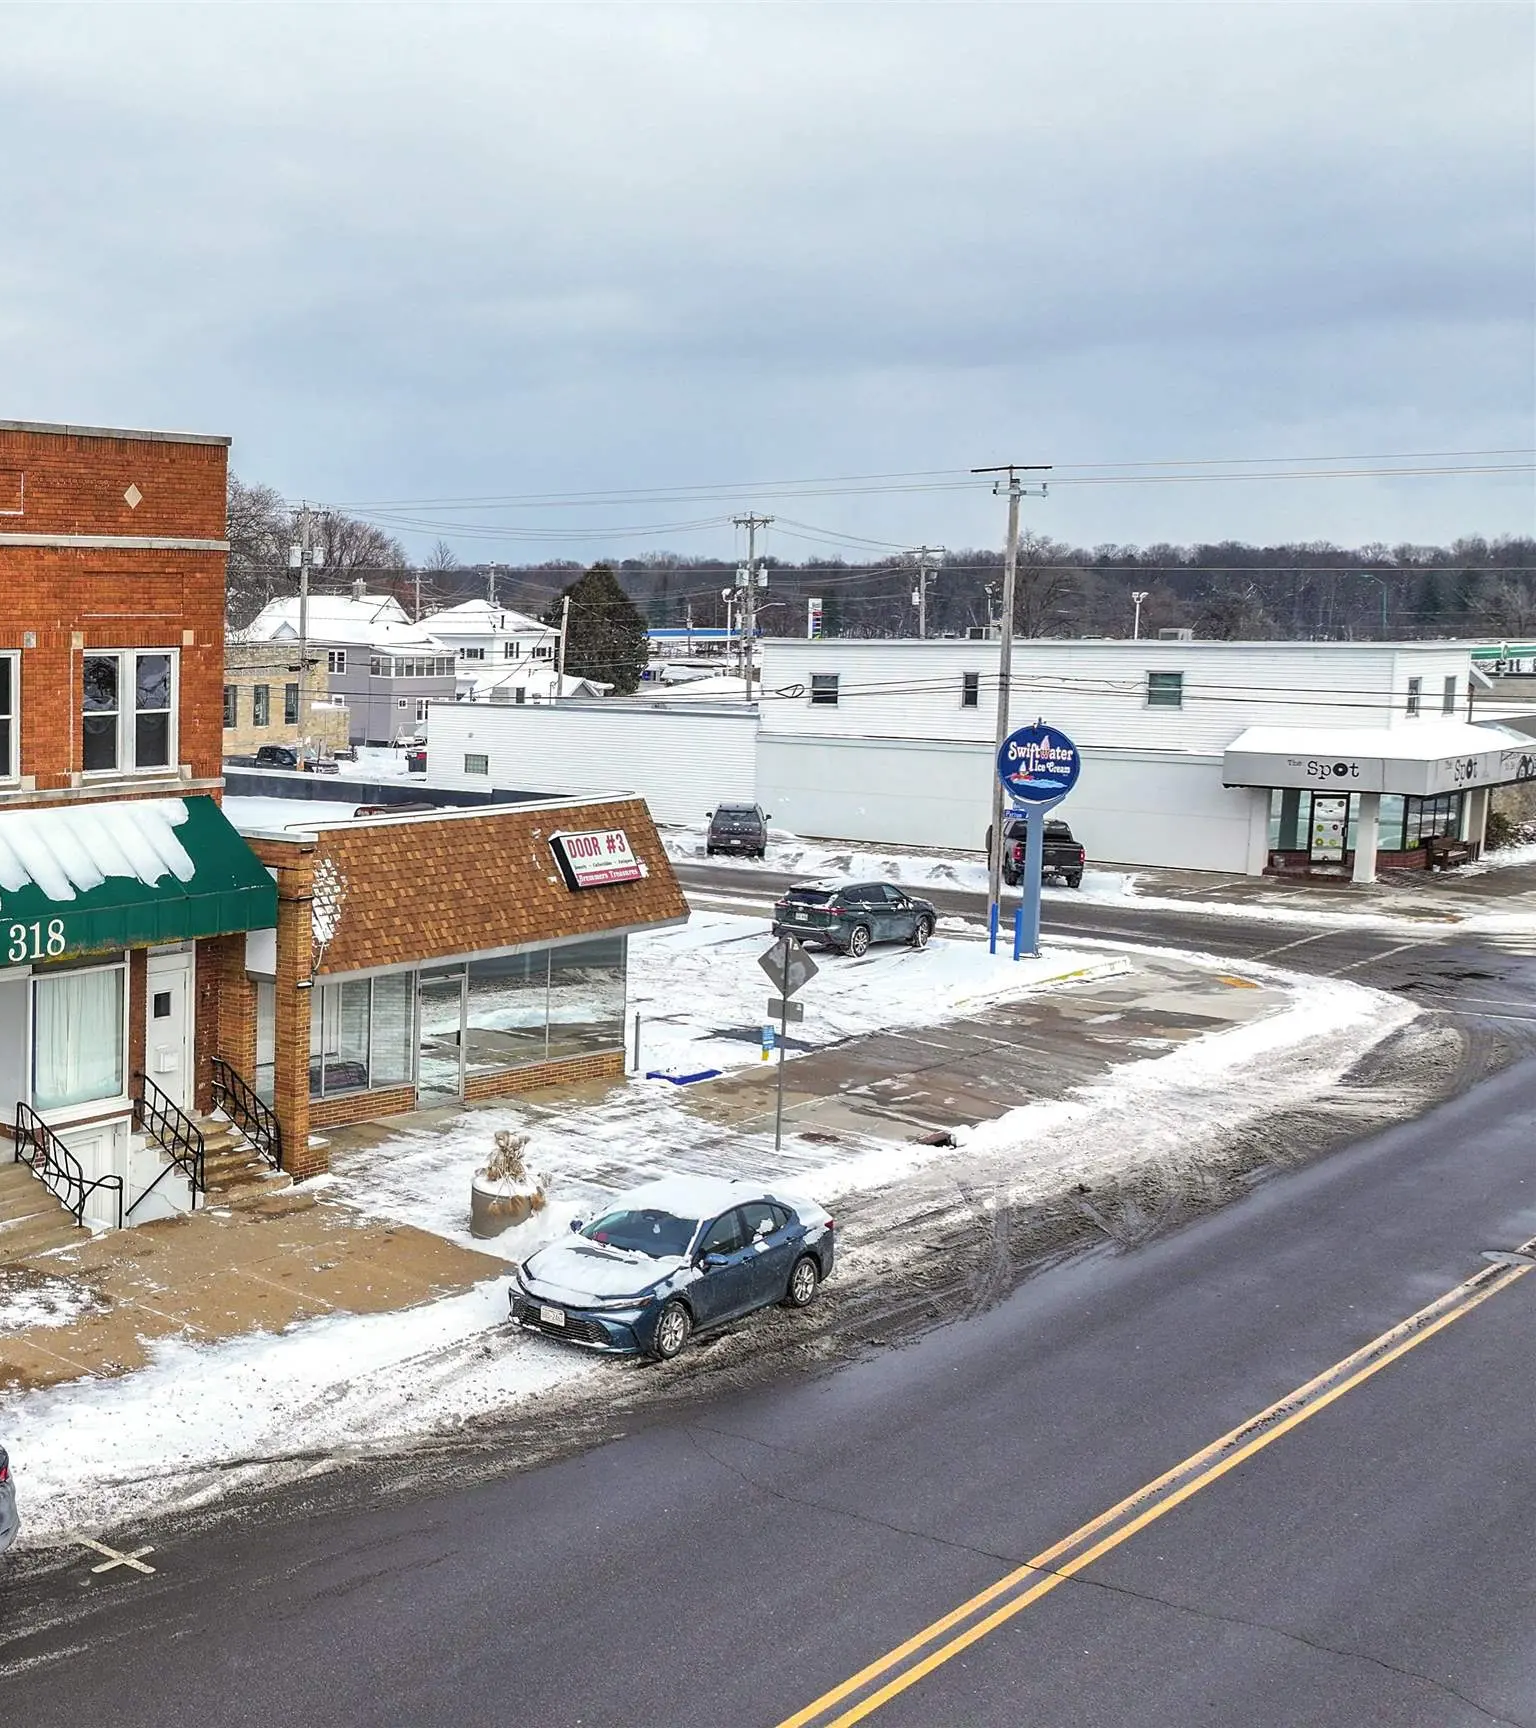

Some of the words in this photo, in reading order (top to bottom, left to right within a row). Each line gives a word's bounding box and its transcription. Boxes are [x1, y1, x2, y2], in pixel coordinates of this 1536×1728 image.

[1008, 741, 1073, 771] Swiftwater
[1034, 760, 1045, 772] Ice
[1047, 762, 1070, 773] Cream
[1307, 761, 1359, 779] Spot
[567, 836, 601, 858] DOOR
[606, 833, 625, 854] #3
[8, 919, 66, 961] 318
